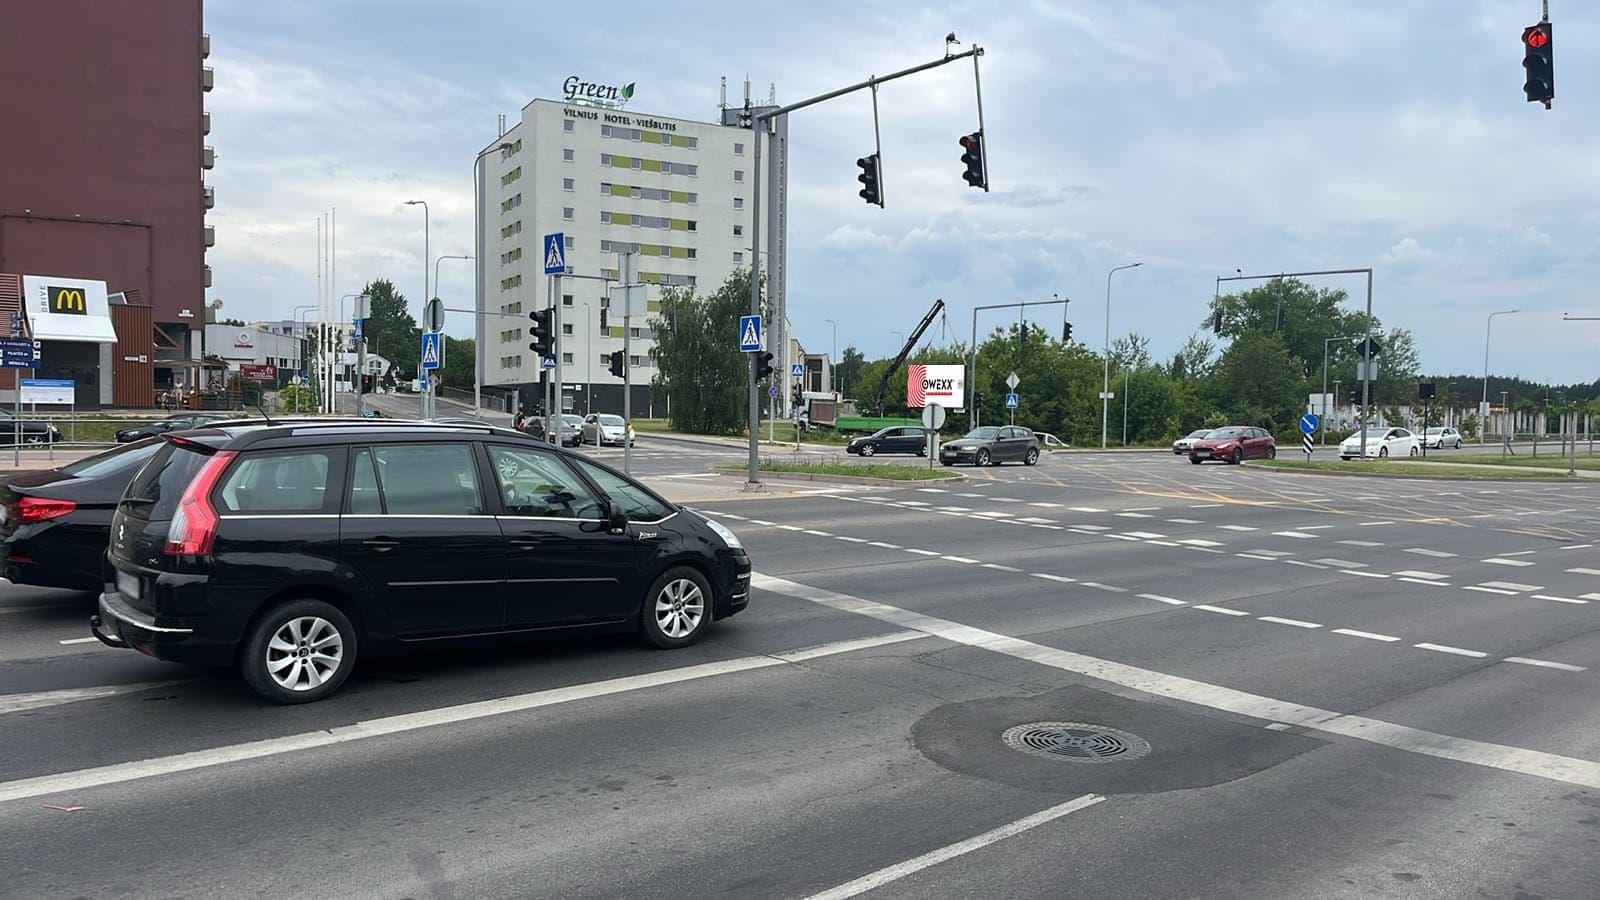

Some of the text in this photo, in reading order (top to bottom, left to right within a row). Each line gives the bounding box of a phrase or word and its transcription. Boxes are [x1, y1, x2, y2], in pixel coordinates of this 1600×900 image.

[563, 75, 618, 100] Green
[563, 108, 677, 131] VILNIUS HOTEL VIEŠBUTIS
[39, 285, 48, 313] DRIVE
